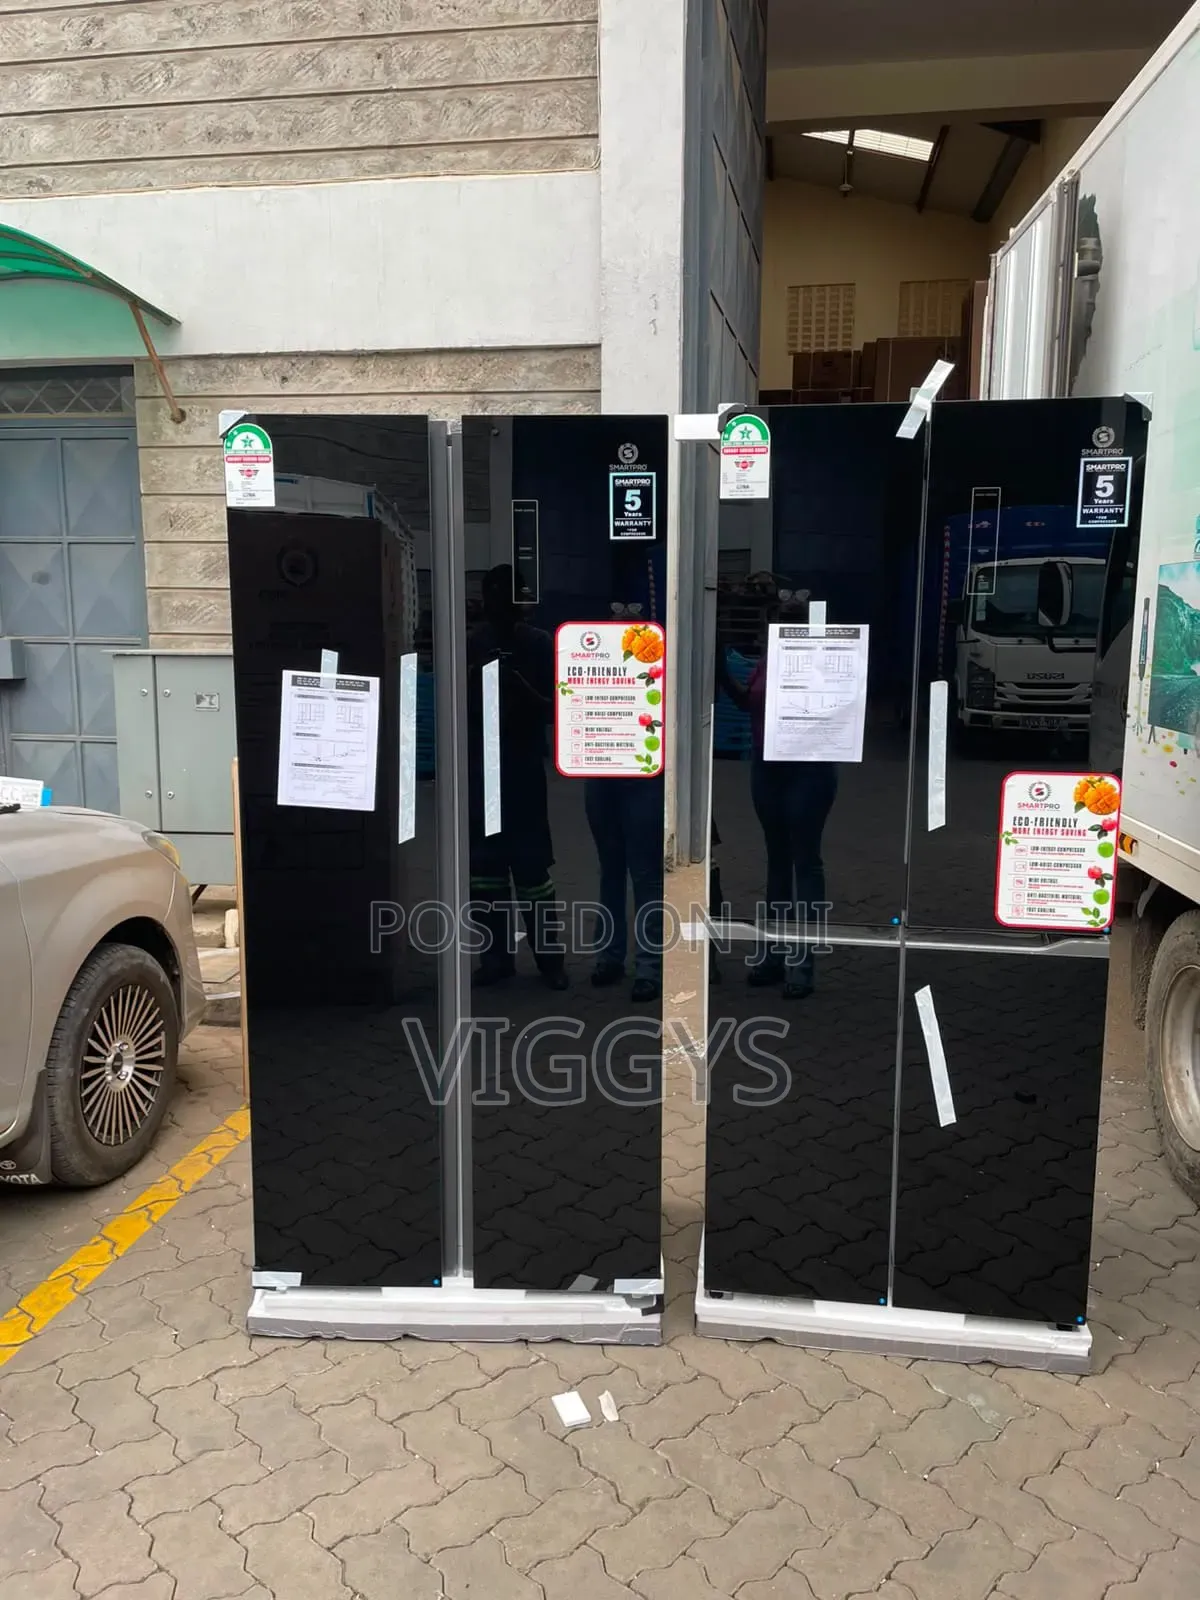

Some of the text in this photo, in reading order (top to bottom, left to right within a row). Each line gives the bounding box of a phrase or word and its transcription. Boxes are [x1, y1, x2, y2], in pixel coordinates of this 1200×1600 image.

[1081, 448, 1124, 456] SMARTPRO
[1095, 475, 1114, 498] 5
[624, 489, 642, 511] 5
[567, 666, 628, 677] ECO-FRIENDLY
[567, 677, 636, 685] MORE ENERGY SAVING
[1017, 802, 1061, 810] SMARTPRO
[1012, 816, 1078, 828] ECO-FRIENDLY
[1012, 827, 1087, 837] MORE ENERGY SAVING
